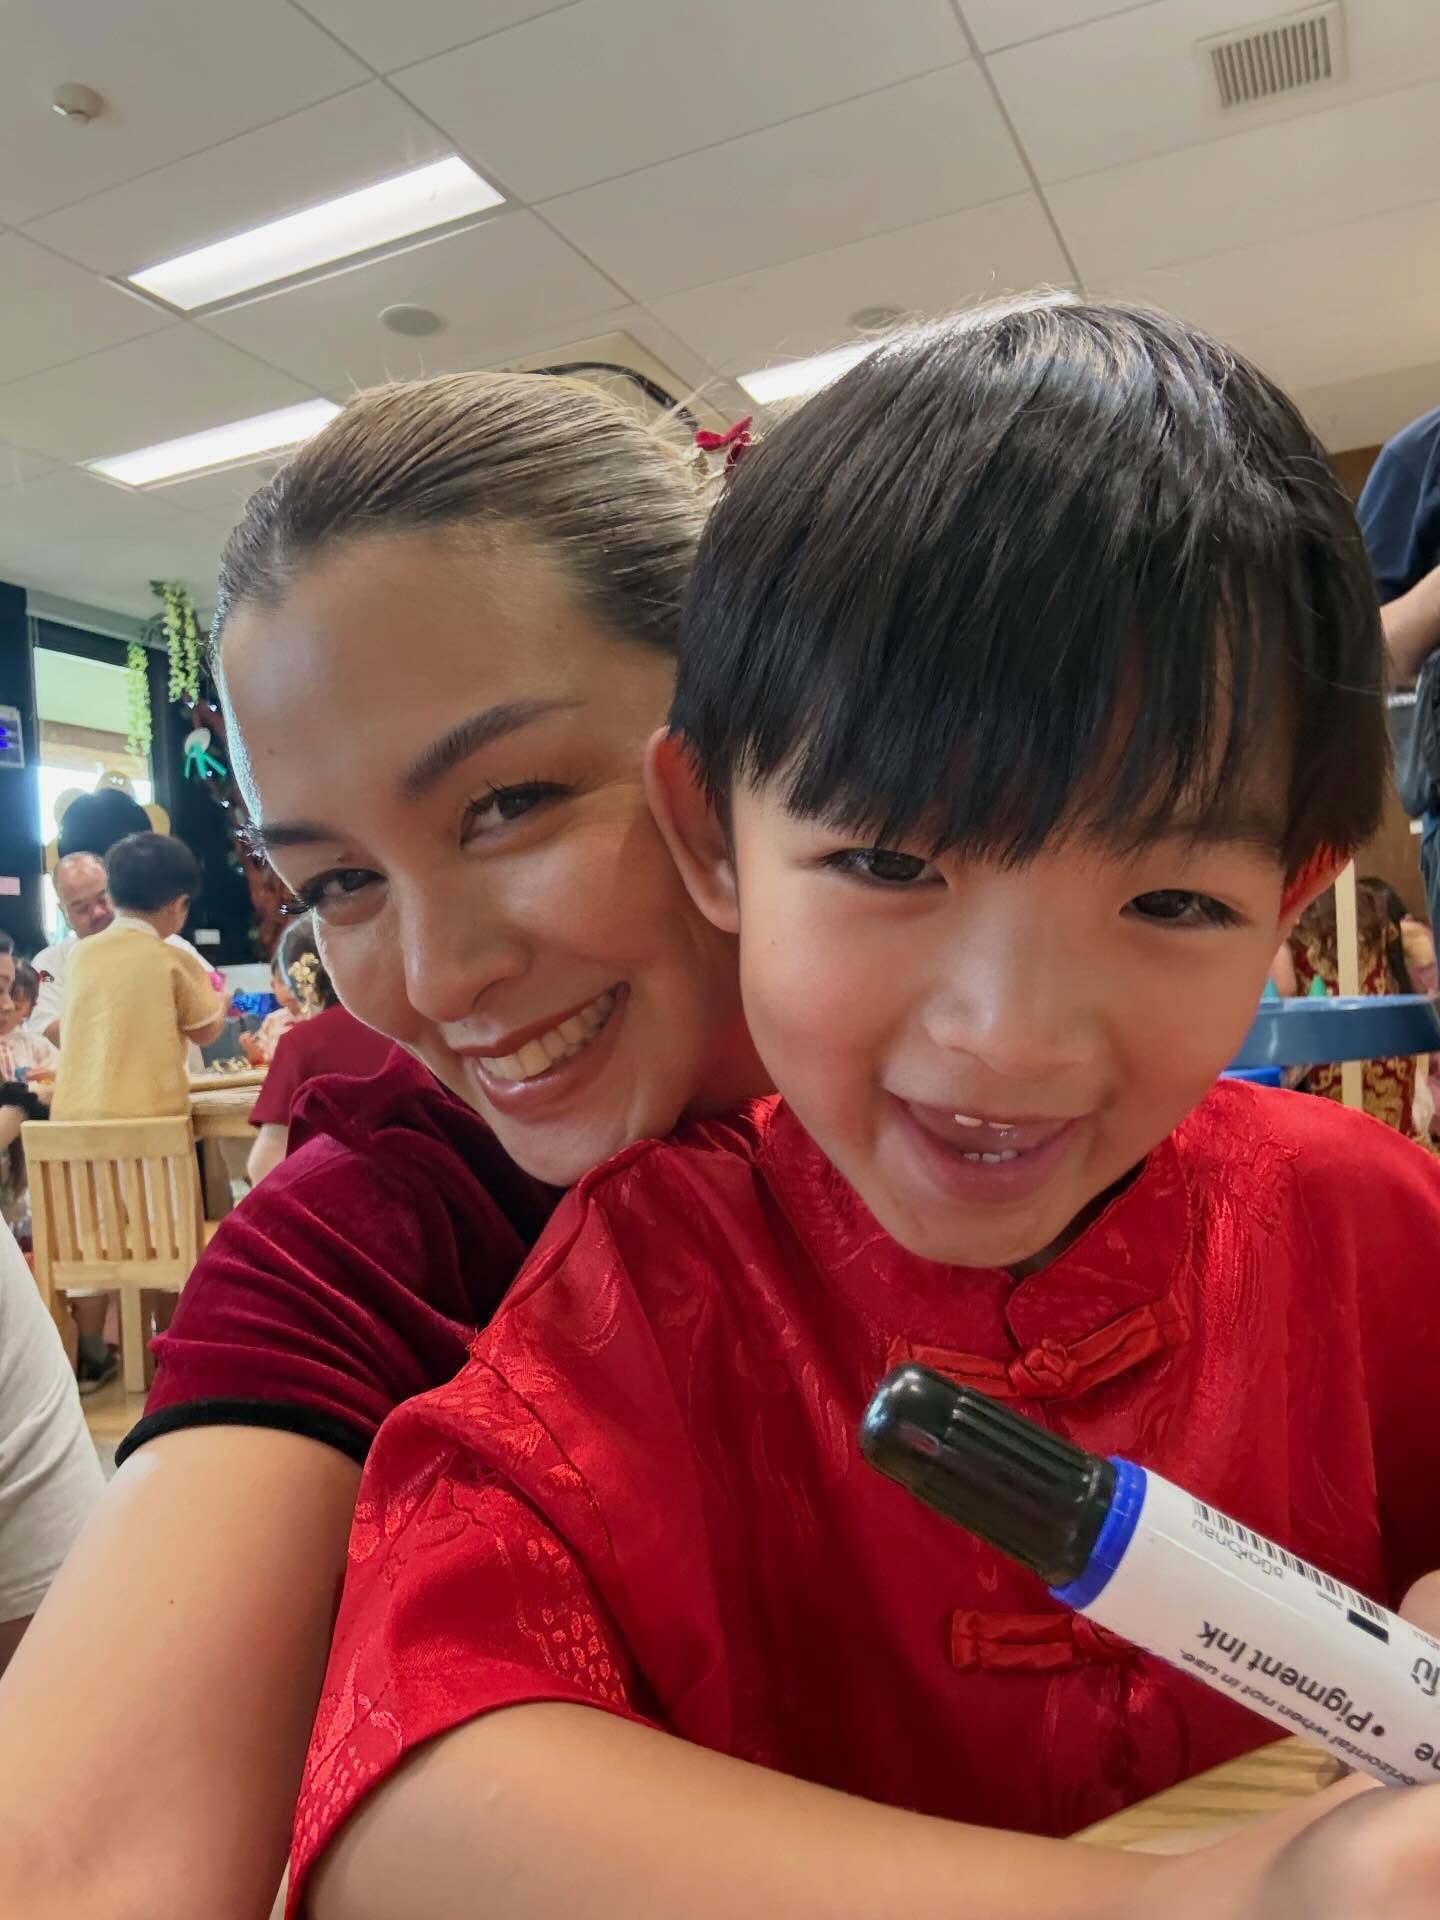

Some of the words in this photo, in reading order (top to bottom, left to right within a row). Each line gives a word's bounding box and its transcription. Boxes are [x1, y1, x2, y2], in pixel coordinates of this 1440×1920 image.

[1197, 1621, 1247, 1664] Ink
[1220, 1671, 1241, 1689] in
[1240, 1686, 1276, 1707] not
[1248, 1649, 1374, 1733] Pigment
[1277, 1704, 1329, 1737] when
